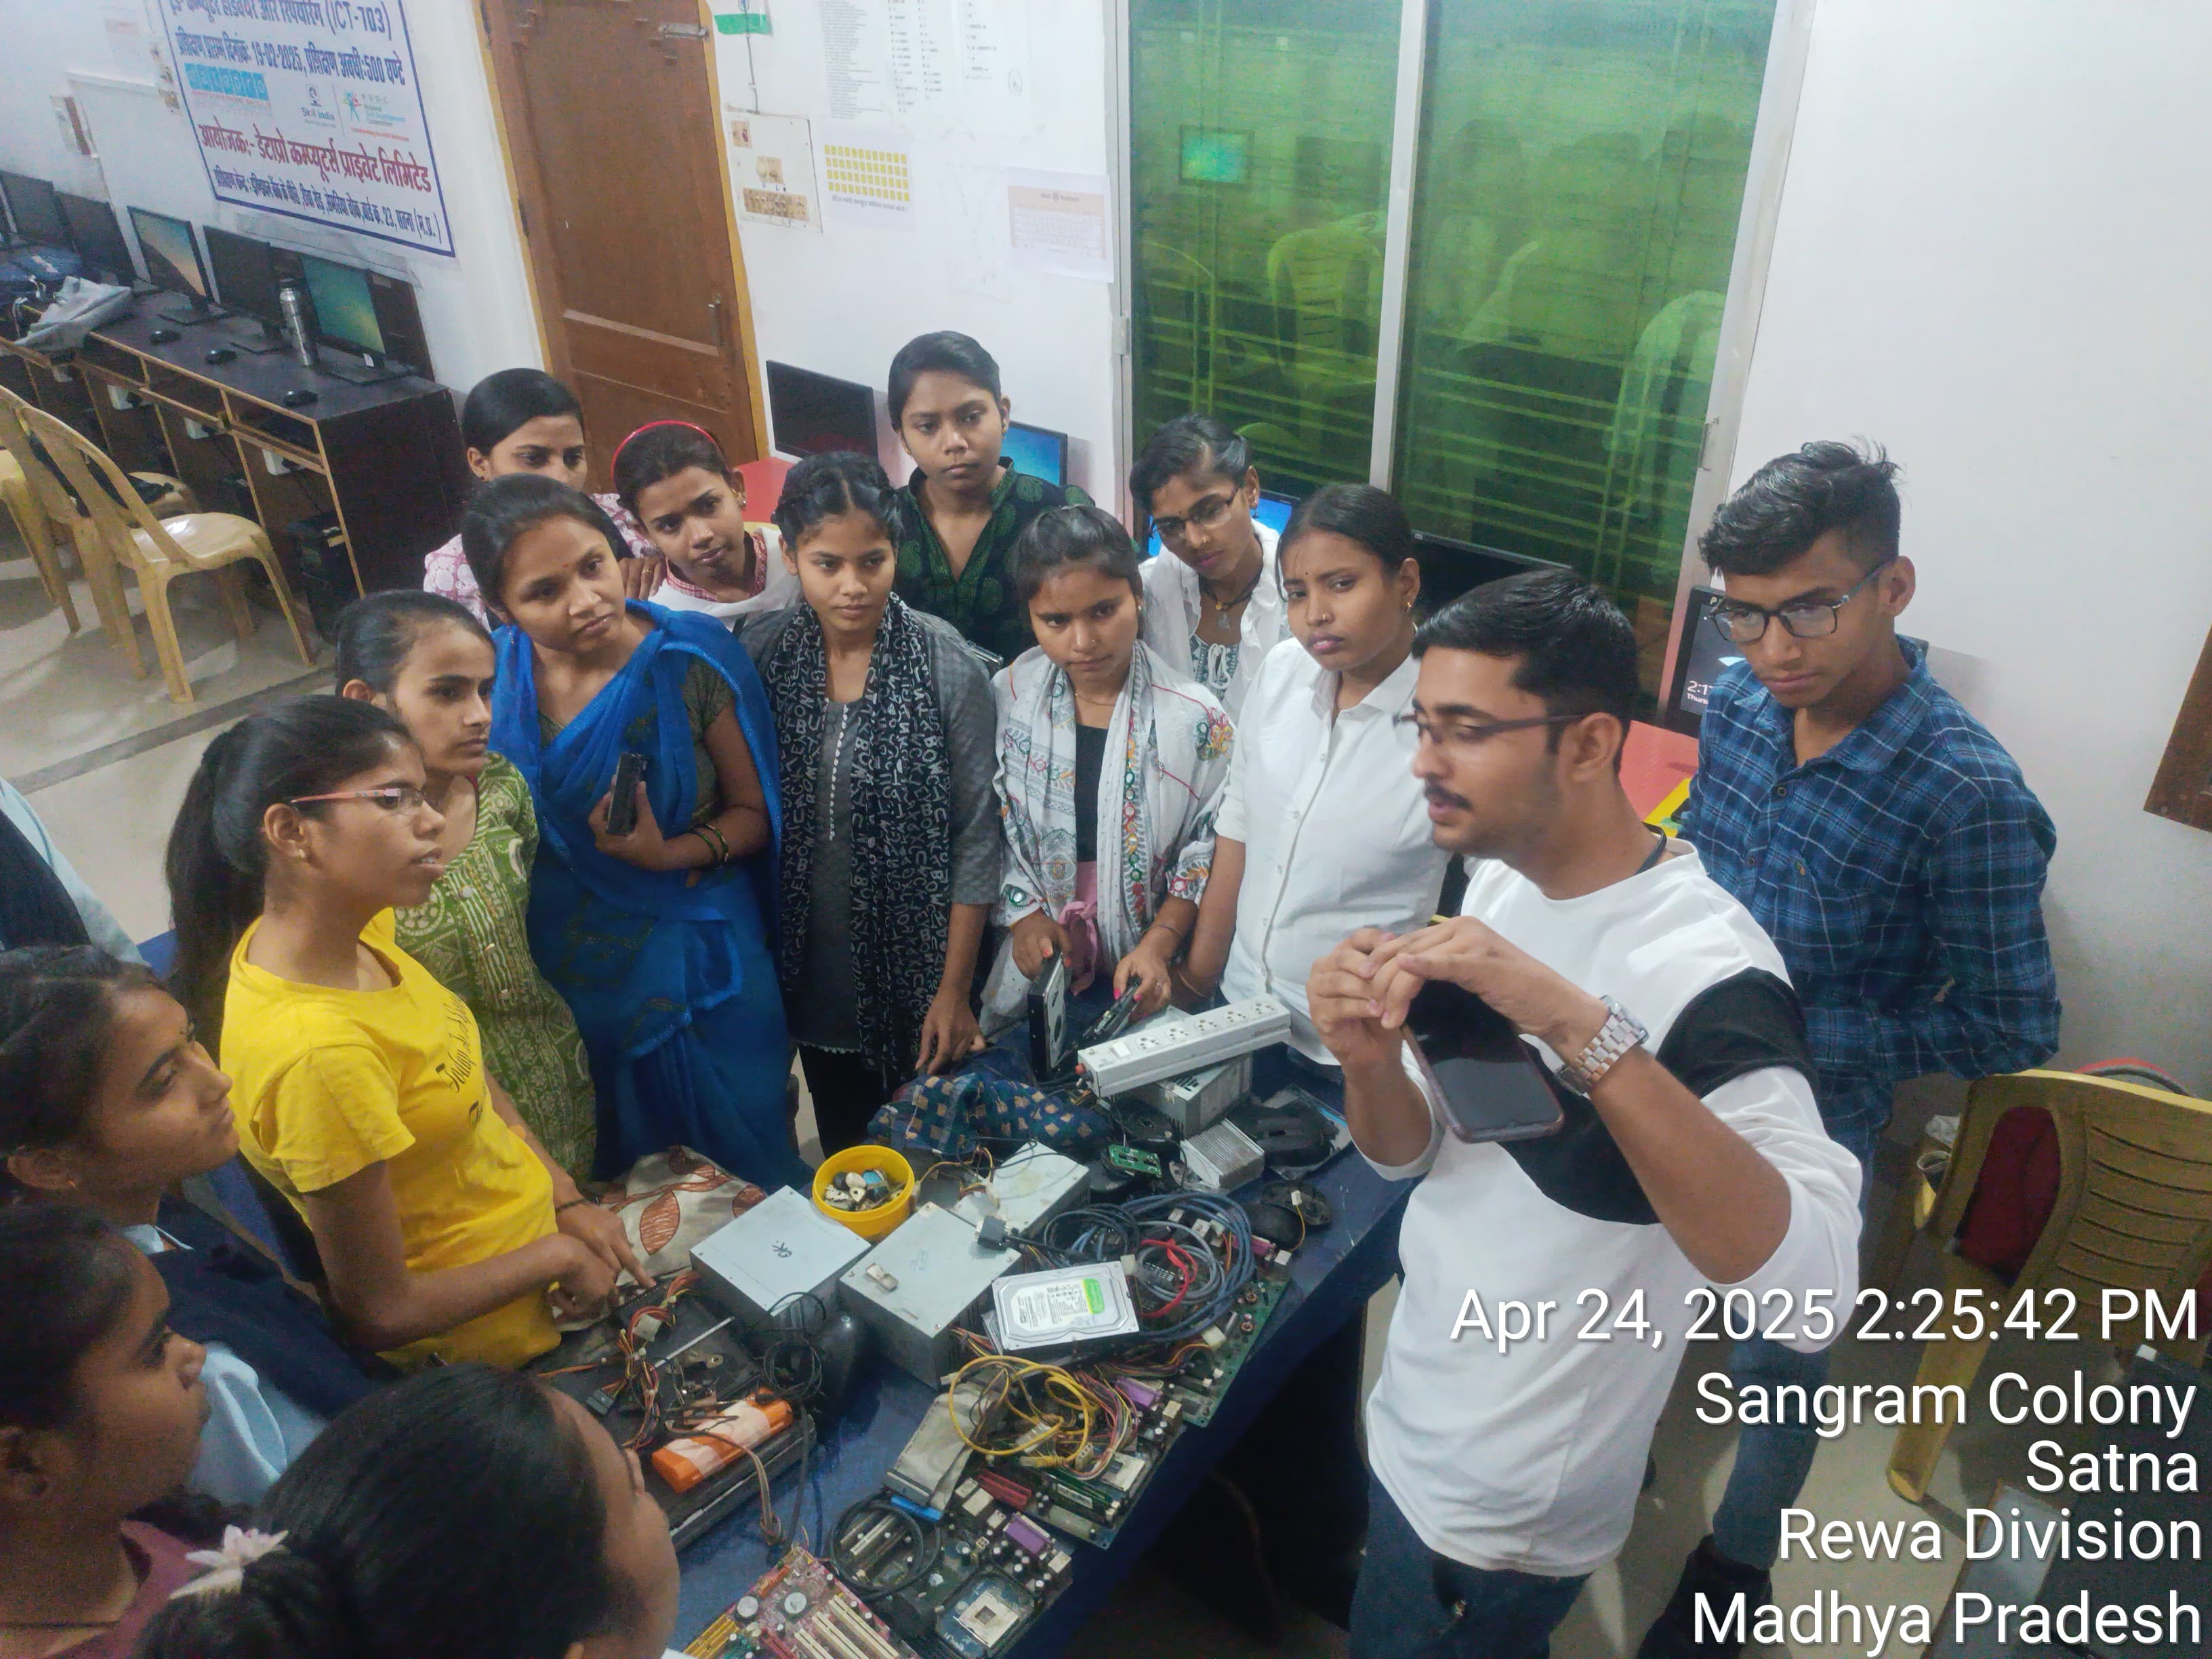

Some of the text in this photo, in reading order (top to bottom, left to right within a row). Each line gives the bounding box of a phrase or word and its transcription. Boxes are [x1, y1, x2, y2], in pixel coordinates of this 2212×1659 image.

[253, 123, 290, 164] डेटाप्रो
[287, 137, 340, 183] कम्प्यूटर्स
[338, 142, 382, 184] प्राइवेट
[378, 146, 432, 193] लिमिटेड
[382, 206, 398, 232] 23,
